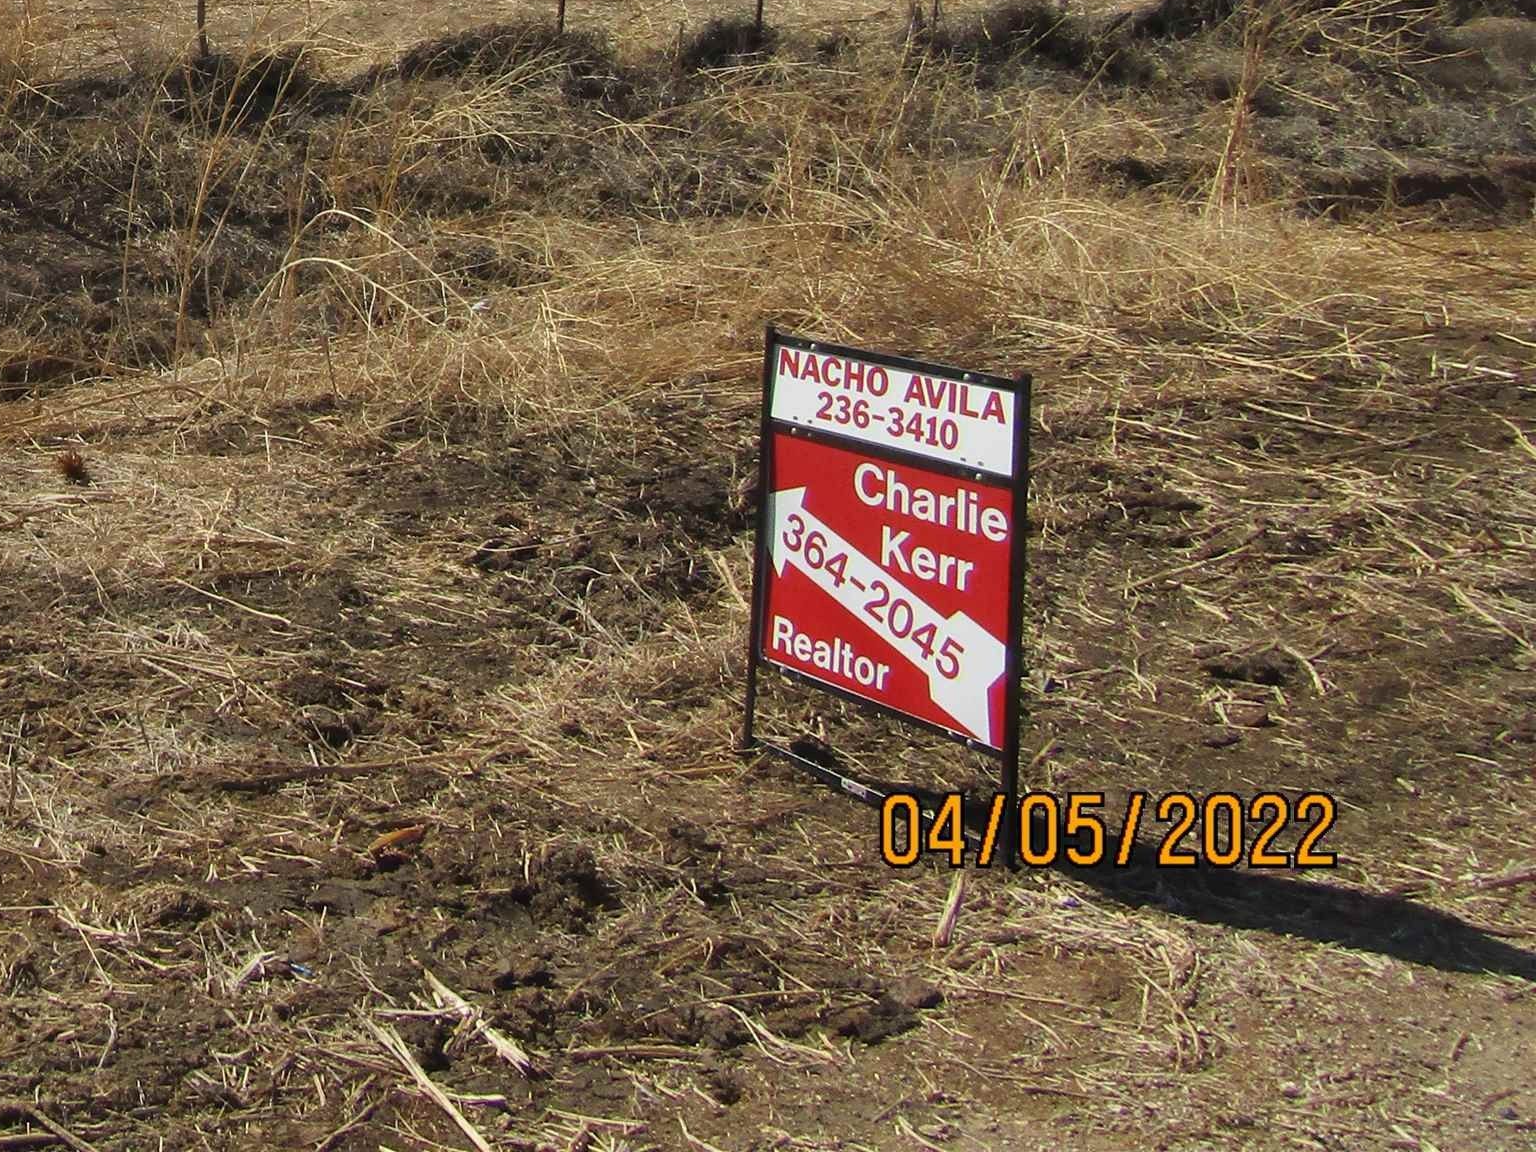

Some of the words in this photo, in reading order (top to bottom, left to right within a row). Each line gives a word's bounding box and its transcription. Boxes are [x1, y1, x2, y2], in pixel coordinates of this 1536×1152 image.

[779, 348, 888, 397] NACHO
[904, 375, 1006, 424] AVILA
[816, 392, 959, 450] 236-3410
[854, 462, 1008, 542] Charlie
[782, 513, 965, 680] 364-2045
[880, 525, 974, 592] Kerr
[772, 615, 890, 691] Realtor
